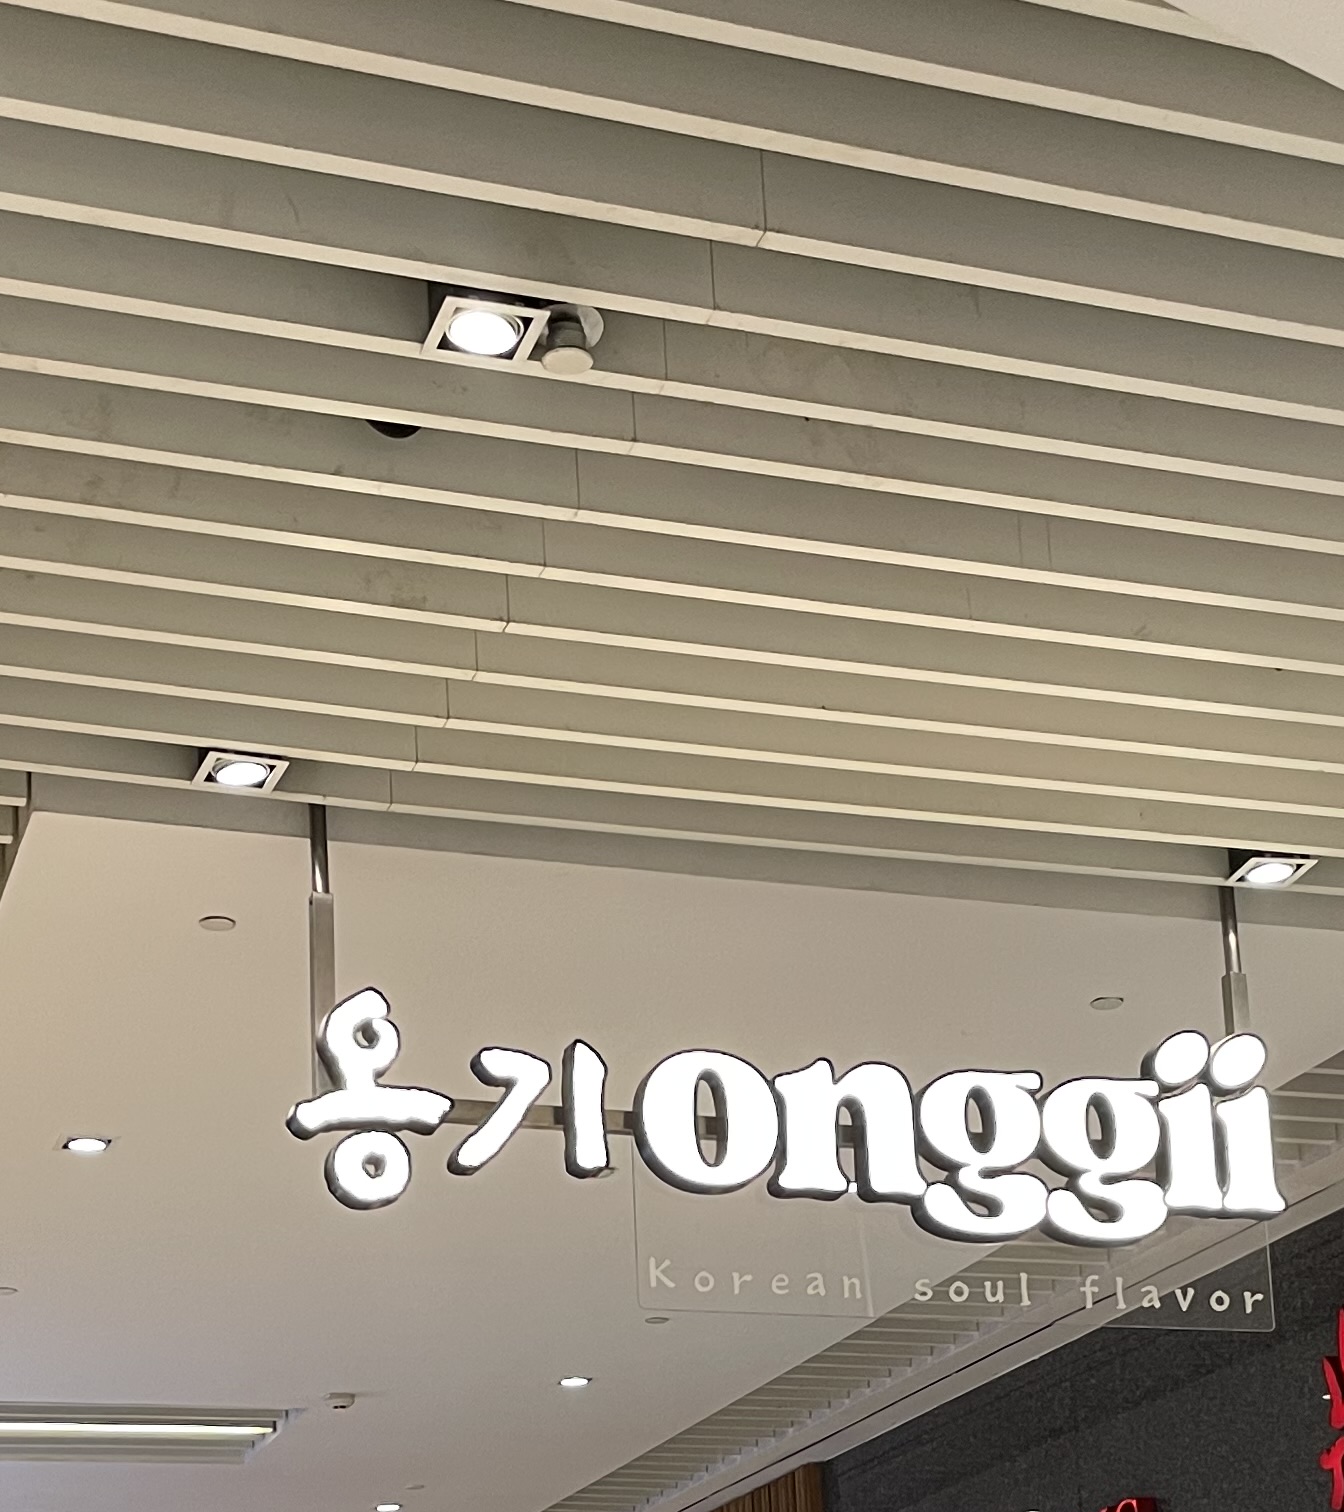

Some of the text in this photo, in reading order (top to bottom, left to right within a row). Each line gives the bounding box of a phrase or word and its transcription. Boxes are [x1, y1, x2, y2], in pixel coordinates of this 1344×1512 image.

[288, 985, 613, 1210] 옹기
[634, 1030, 1286, 1246] Onggii
[648, 1257, 1265, 1314] Korean soul flavor
